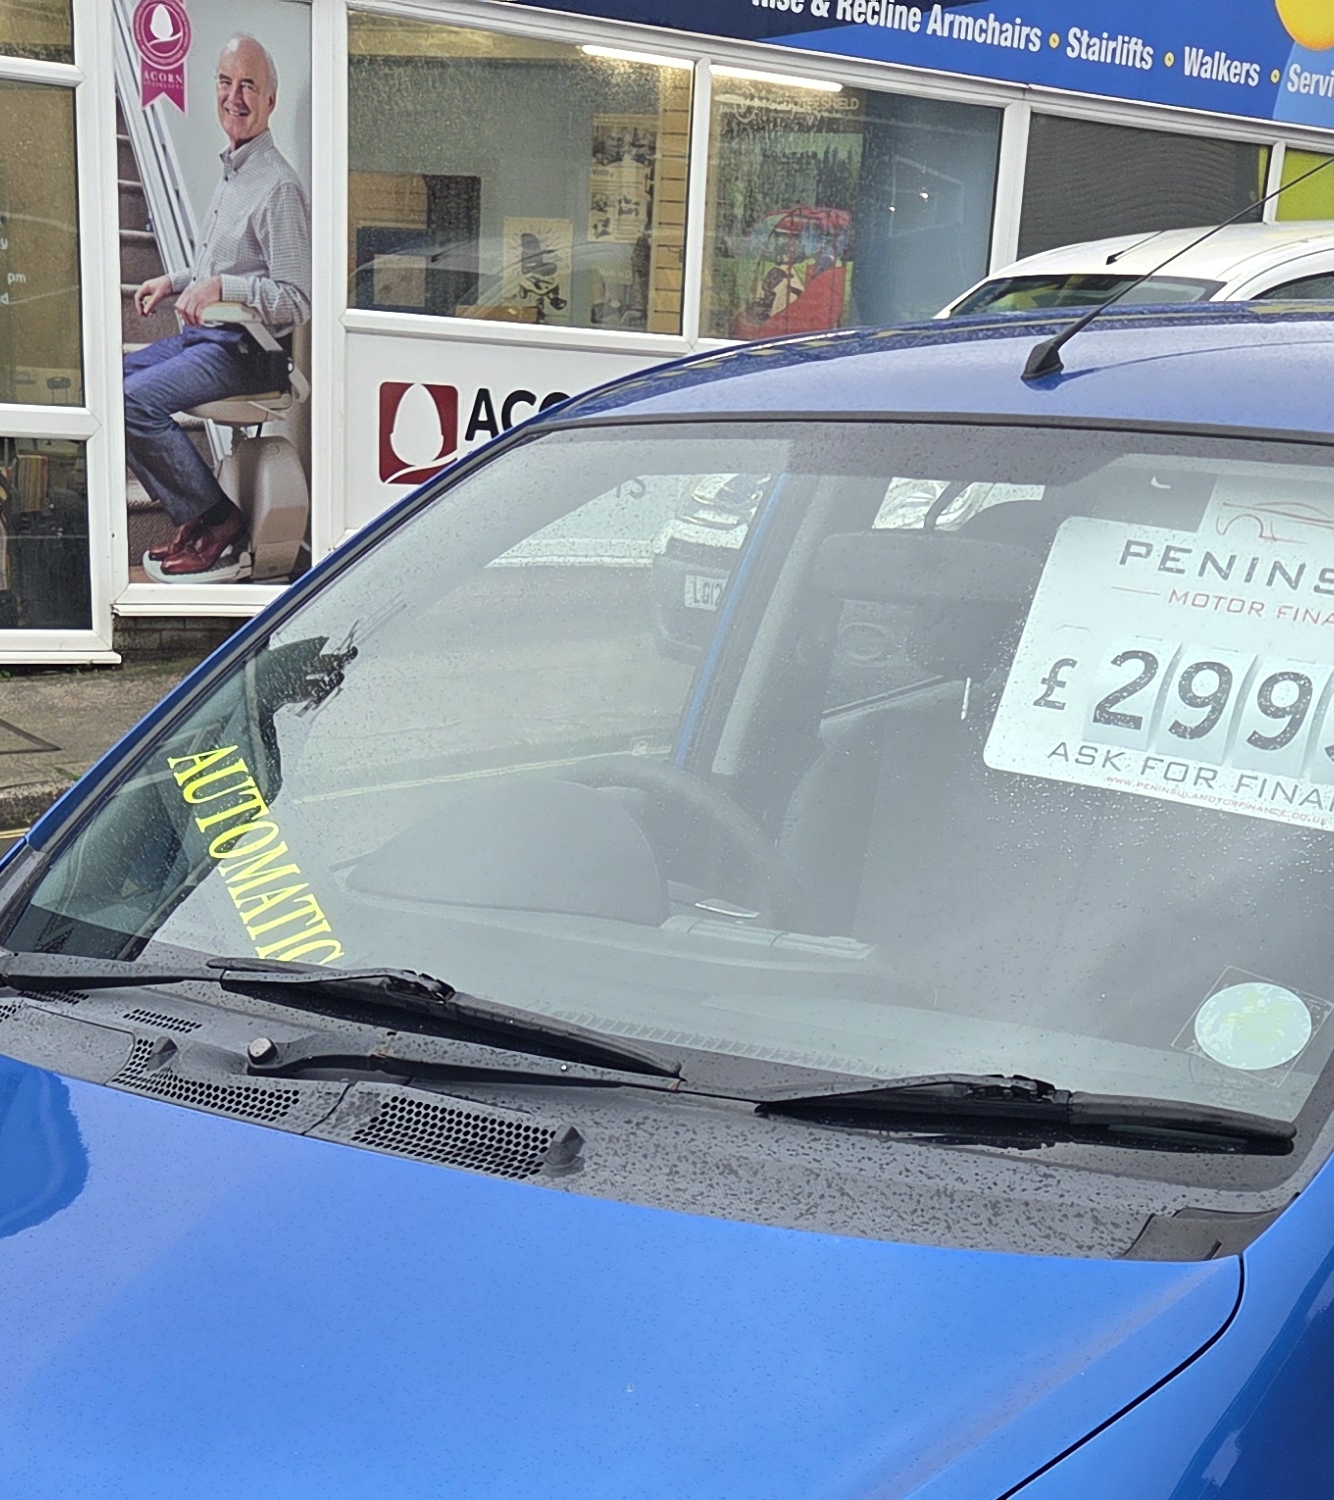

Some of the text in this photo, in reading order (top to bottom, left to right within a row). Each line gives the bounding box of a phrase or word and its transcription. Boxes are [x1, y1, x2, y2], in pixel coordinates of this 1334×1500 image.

[836, 0, 921, 33] Recline
[926, 4, 1041, 52] Armchairs
[1066, 26, 1154, 71] Stairlifts
[1184, 46, 1261, 88] Walkers
[142, 70, 183, 84] ACORN
[7, 272, 27, 285] pm
[1168, 589, 1266, 617] MOTOR
[1047, 742, 1126, 772] ASK
[1140, 756, 1218, 790] FOR
[167, 745, 345, 965] AUTOMATIC
